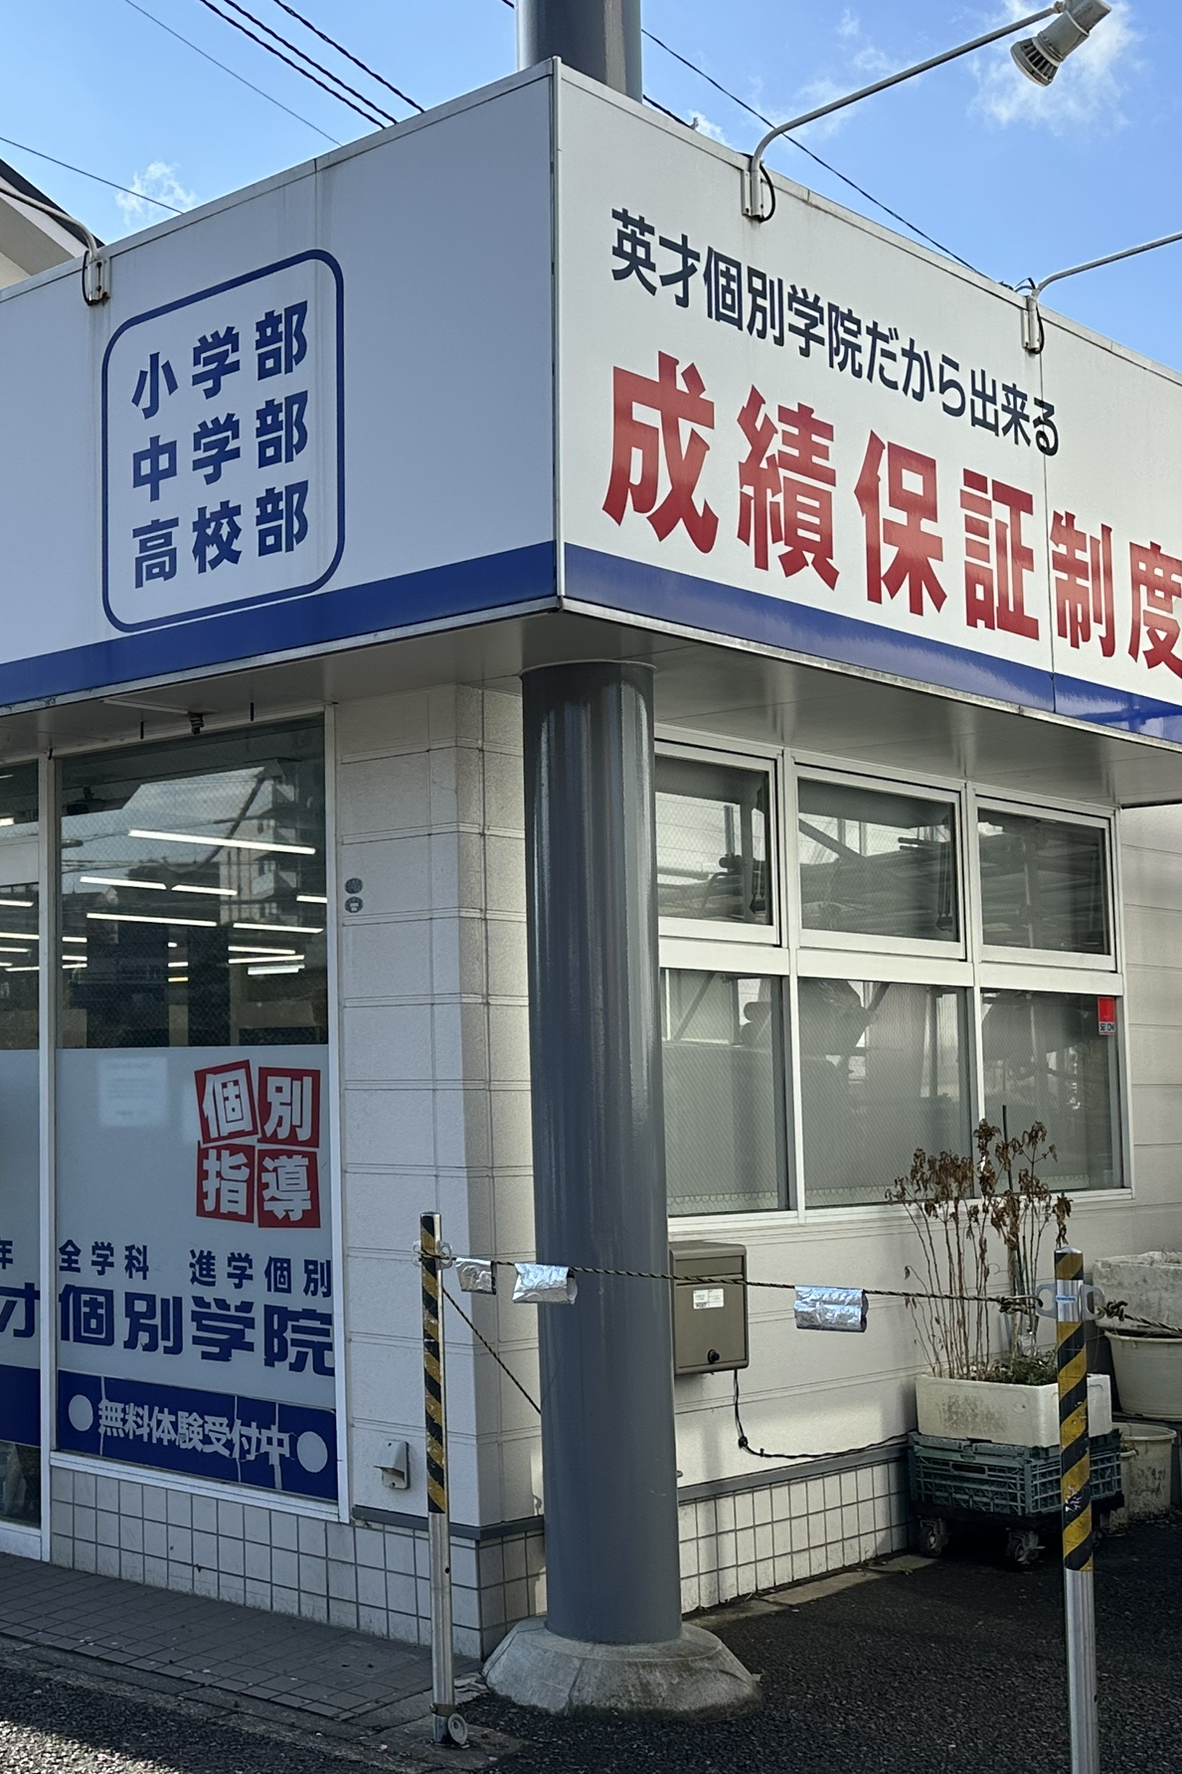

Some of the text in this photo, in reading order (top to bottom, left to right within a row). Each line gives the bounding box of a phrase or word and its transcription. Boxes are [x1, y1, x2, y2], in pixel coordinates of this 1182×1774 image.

[131, 300, 308, 419] 小学部
[611, 208, 1059, 457] 英才個別学院だから出来る
[132, 390, 309, 502] 中学部
[133, 479, 309, 590] 高校部
[602, 350, 1182, 680] 成績保証制度
[202, 1067, 315, 1142] 個別
[202, 1149, 313, 1222] 指導
[59, 1239, 150, 1280] 全学科
[189, 1249, 333, 1298] 進学個別
[98, 1399, 290, 1465] 無料体験受付中
